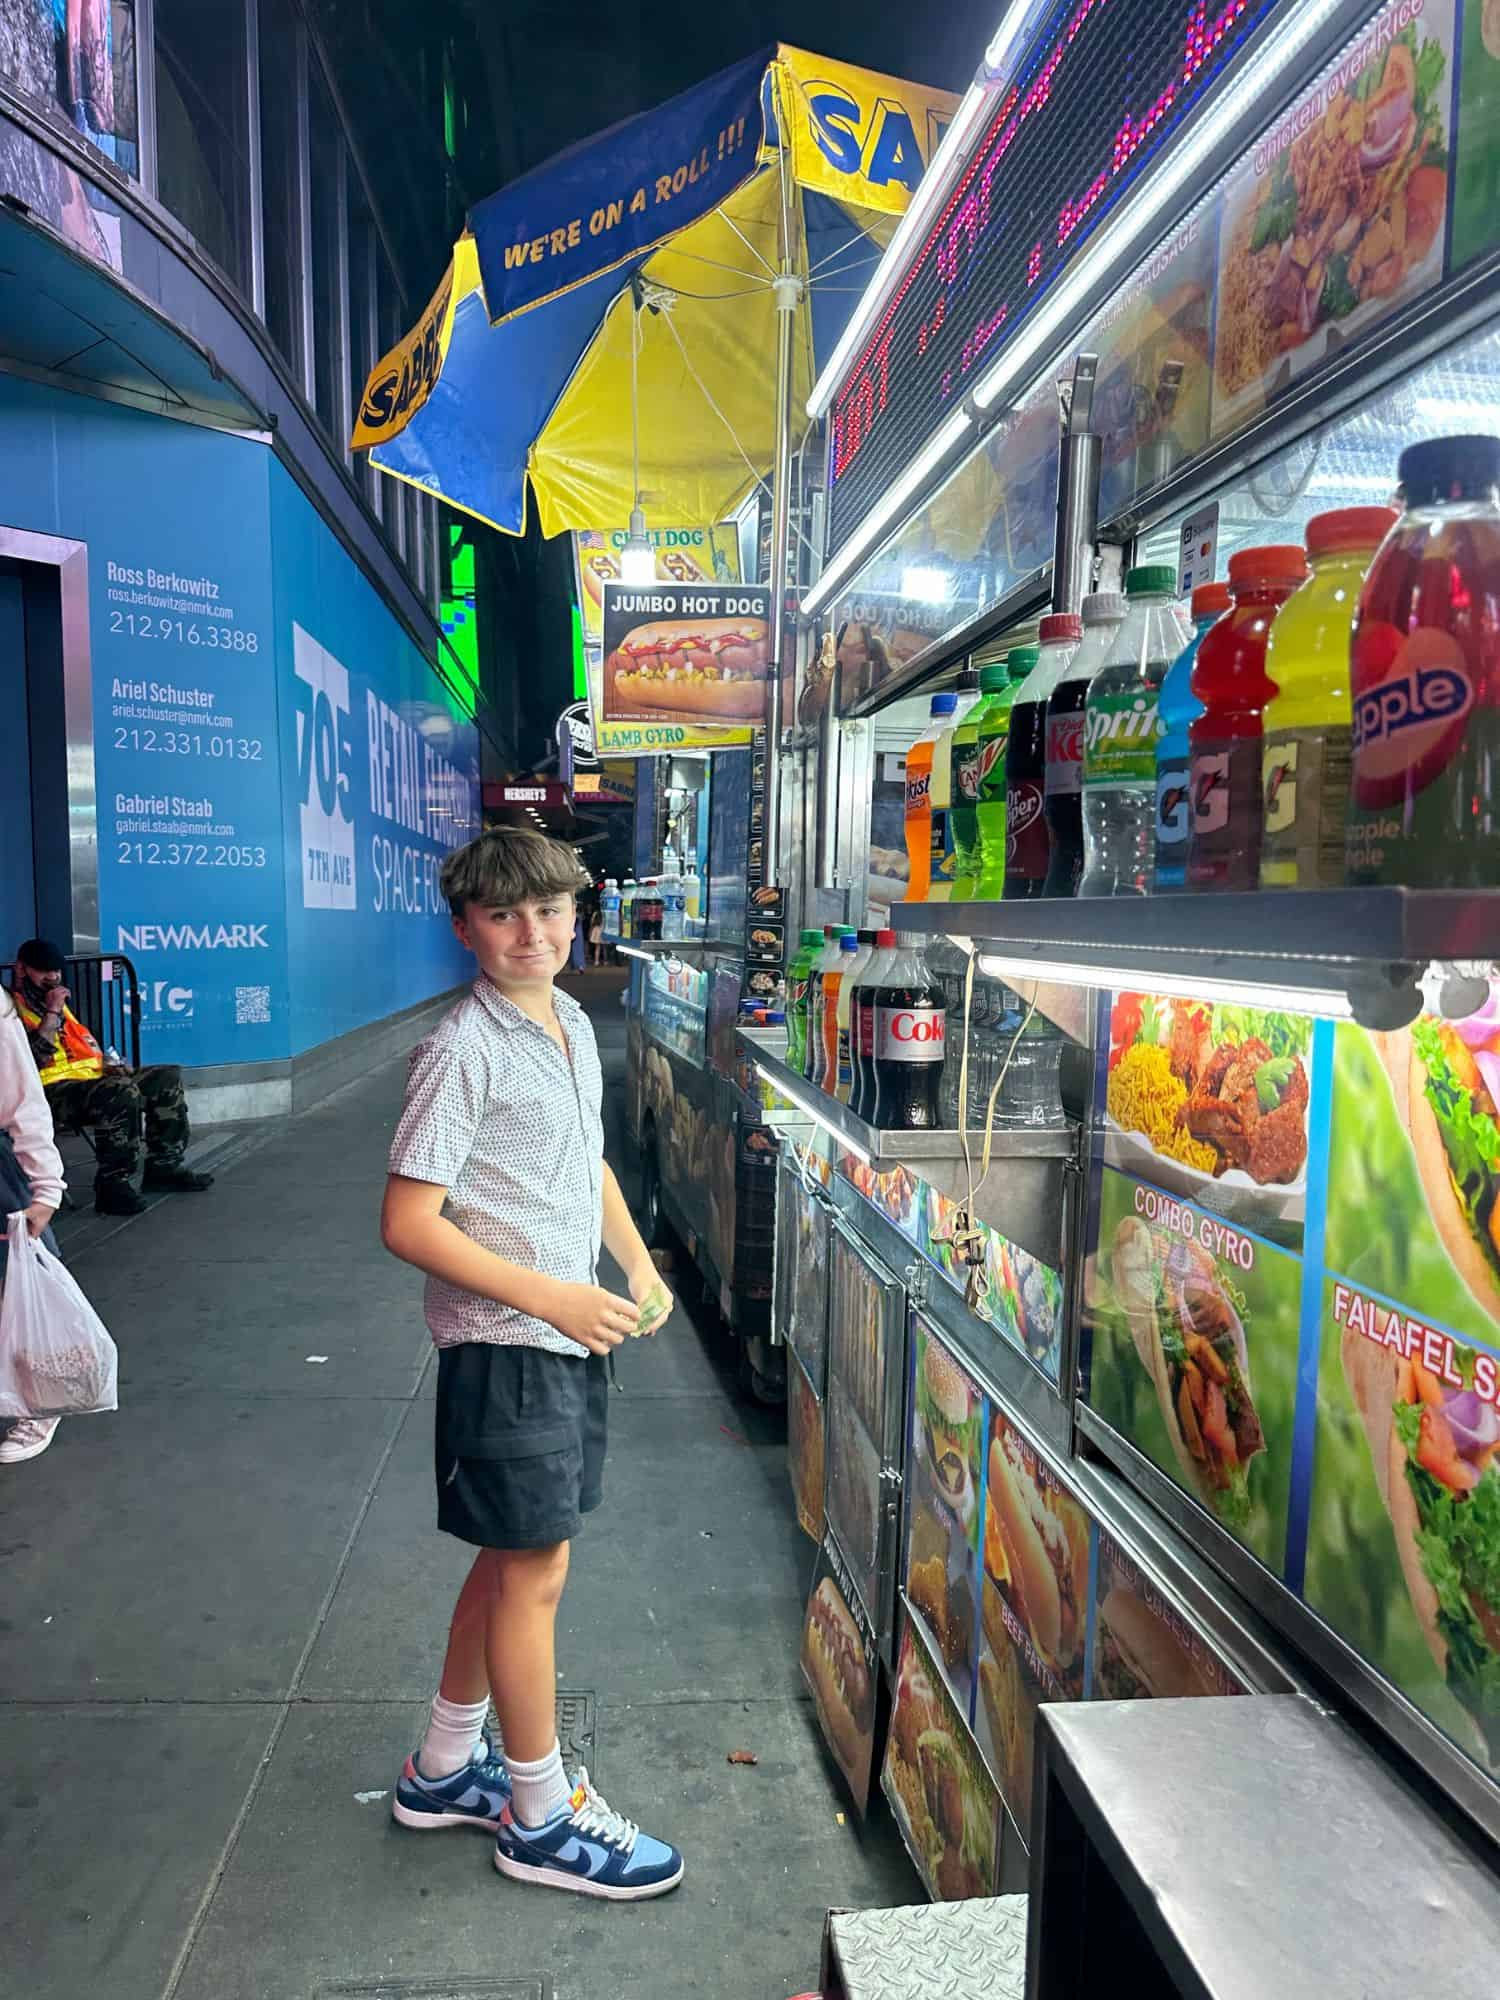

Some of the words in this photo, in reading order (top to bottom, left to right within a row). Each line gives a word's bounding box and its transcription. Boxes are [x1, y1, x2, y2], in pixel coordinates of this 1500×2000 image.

[504, 218, 580, 270] WE'RE
[590, 199, 622, 235] ON
[630, 188, 646, 214] A
[656, 147, 710, 204] ROLL
[665, 530, 704, 546] DOG
[107, 561, 144, 585] Ross
[147, 569, 219, 599] Berkowitz
[611, 595, 676, 613] JUMBO
[682, 596, 720, 614] HOT
[725, 598, 764, 615] DOG
[110, 611, 258, 653] 212.916.3388
[112, 678, 146, 701] Ariel
[150, 683, 214, 708] Schuster
[114, 727, 263, 761] 212.331.0132
[602, 730, 641, 747] LAMB
[646, 727, 685, 745] GYRO
[367, 688, 424, 836] RETAIL
[116, 793, 169, 815] Gabriel
[172, 799, 213, 817] Staab
[118, 842, 266, 867] 212.372.2053
[308, 848, 329, 884] 7TH
[333, 854, 351, 887] AVE
[372, 834, 421, 914] SPACE
[118, 924, 269, 951] NEWMARK
[1134, 1186, 1194, 1239] COMBO
[1199, 1213, 1254, 1271] GYRO
[1333, 1284, 1463, 1386] FALAFEL
[1473, 1356, 1500, 1415] S
